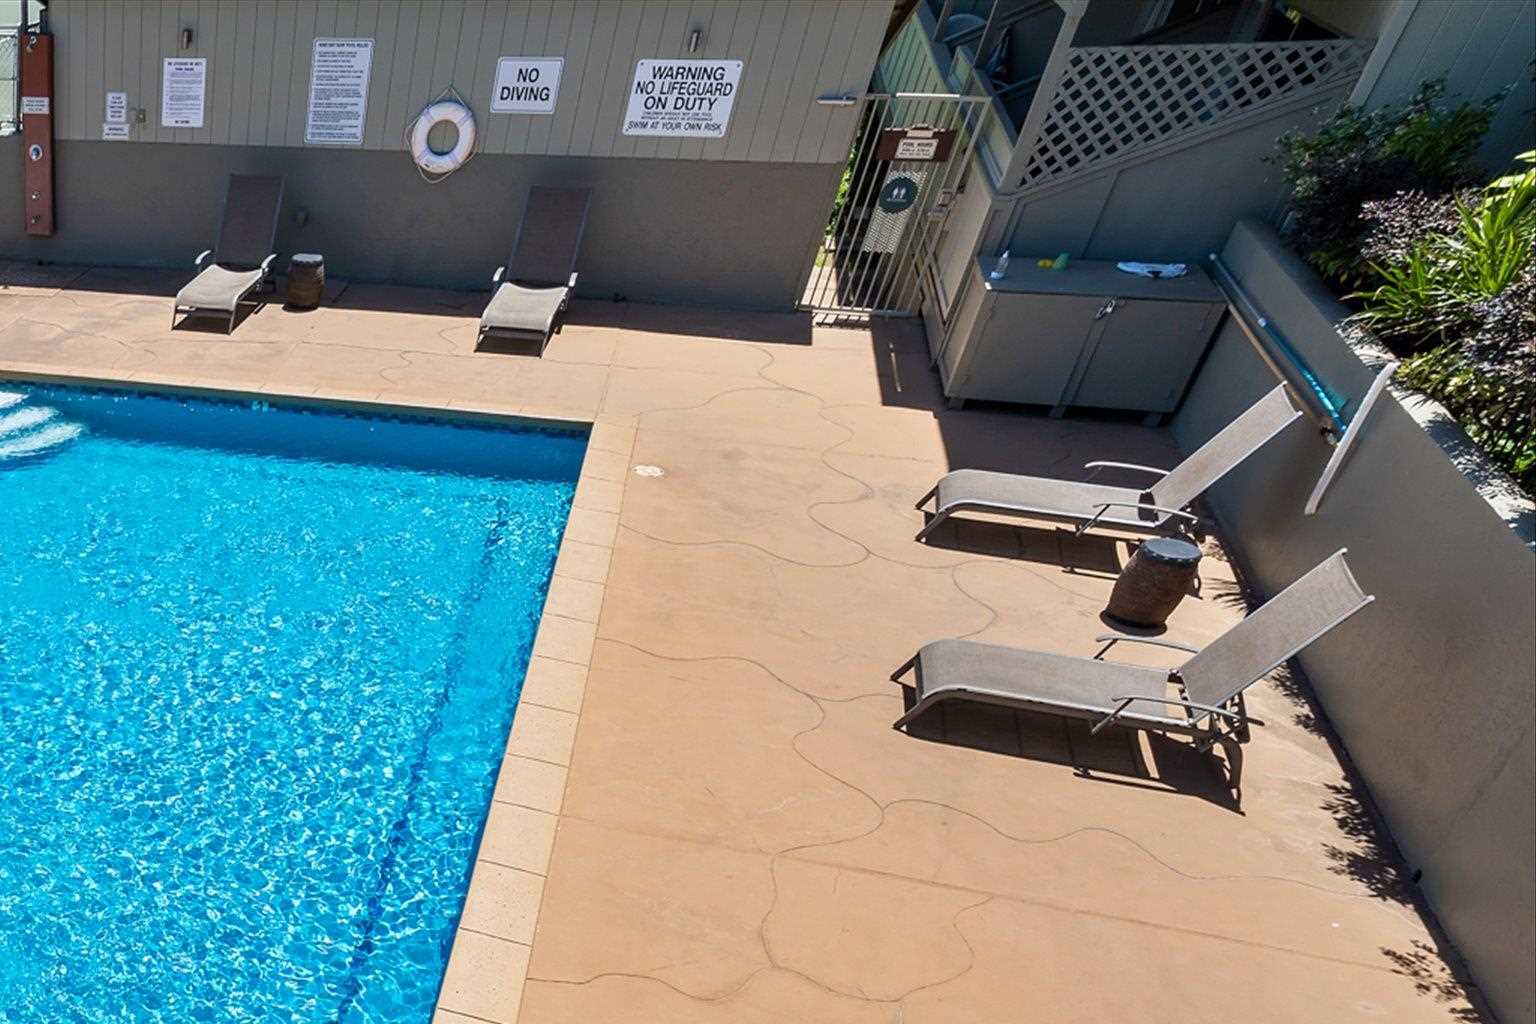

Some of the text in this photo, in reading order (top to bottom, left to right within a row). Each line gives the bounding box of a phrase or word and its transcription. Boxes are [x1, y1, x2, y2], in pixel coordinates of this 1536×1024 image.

[517, 67, 539, 83] NO
[652, 65, 726, 81] WARNING
[500, 86, 550, 101] DIVING
[635, 81, 734, 96] NO LIFEGUARD
[644, 96, 718, 111] ON DUTY
[627, 120, 722, 131] SWIM AT YOUR OWN RISK
